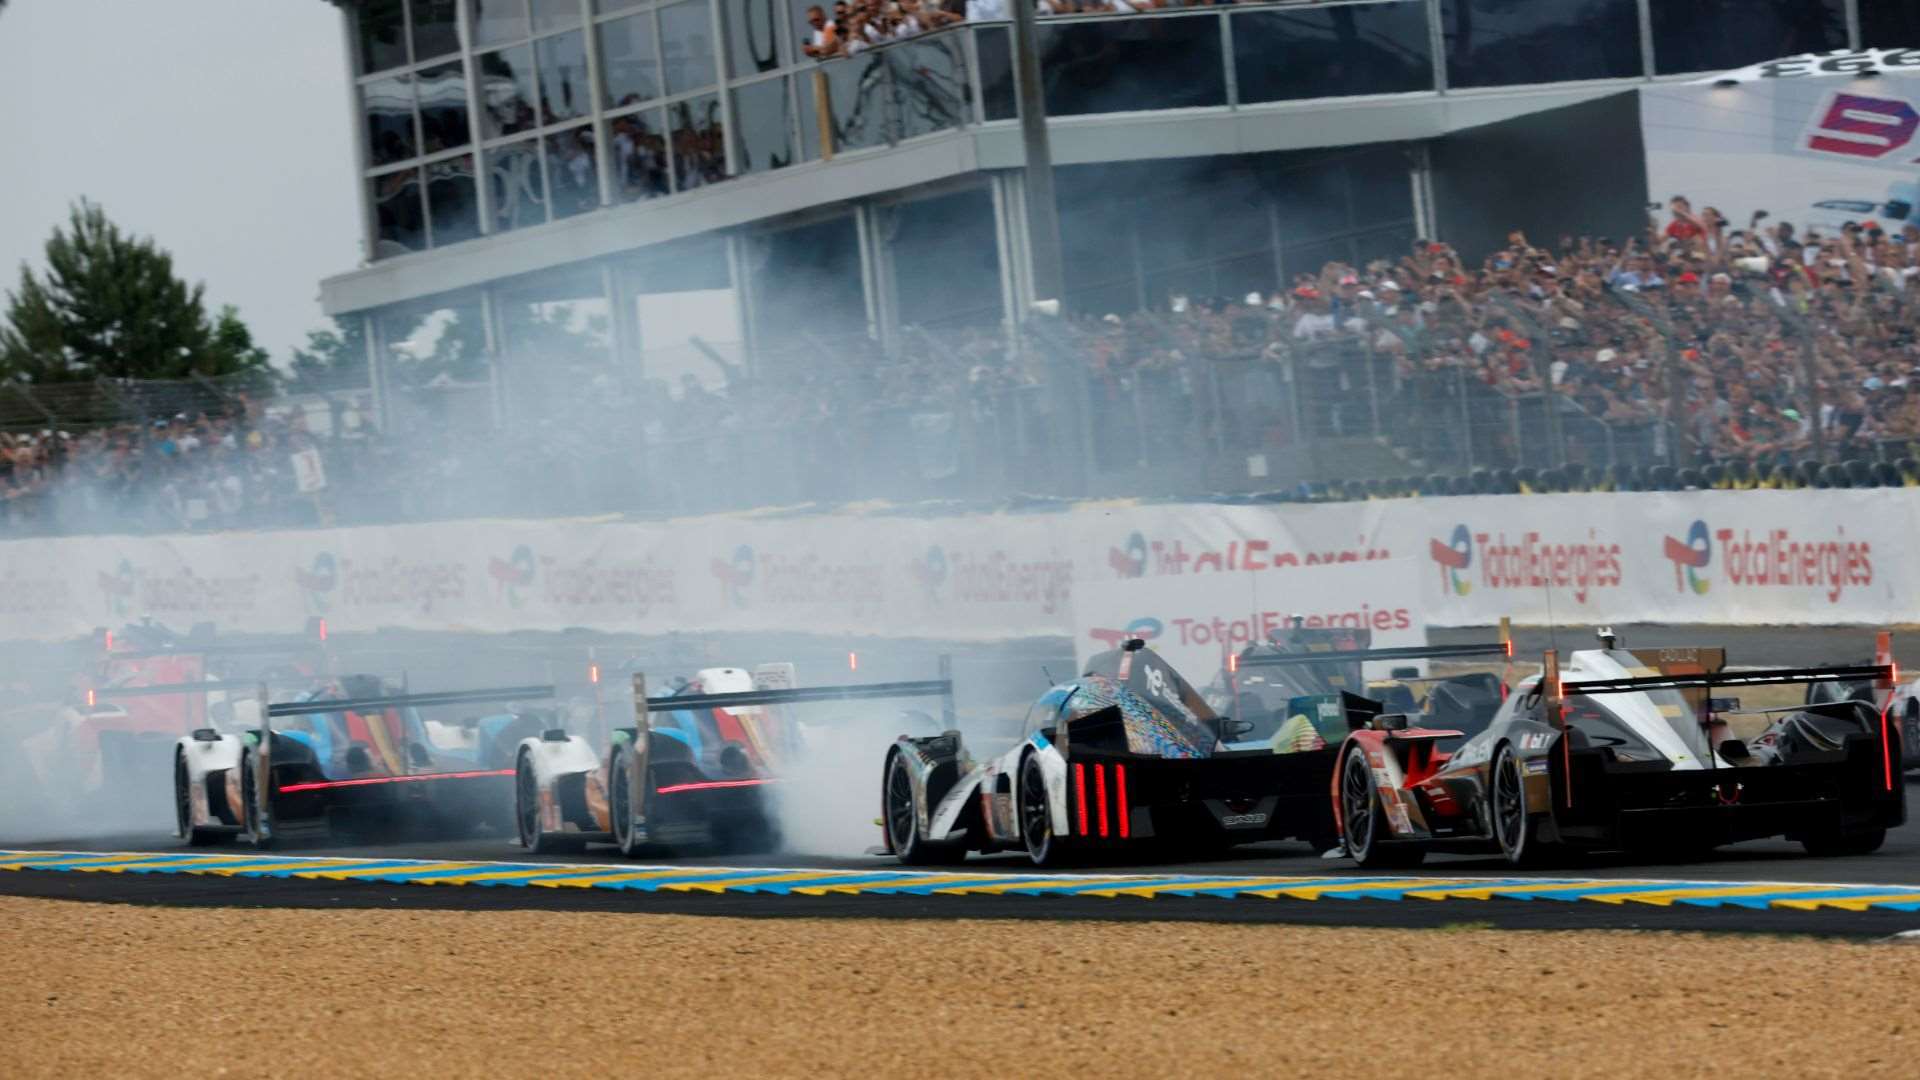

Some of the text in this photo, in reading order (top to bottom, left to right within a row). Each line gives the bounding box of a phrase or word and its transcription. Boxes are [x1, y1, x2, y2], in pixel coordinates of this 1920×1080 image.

[1151, 533, 1391, 576] TotalEi
[1475, 527, 1622, 605] TotalEnergies
[1716, 525, 1873, 604] TotalEnergies
